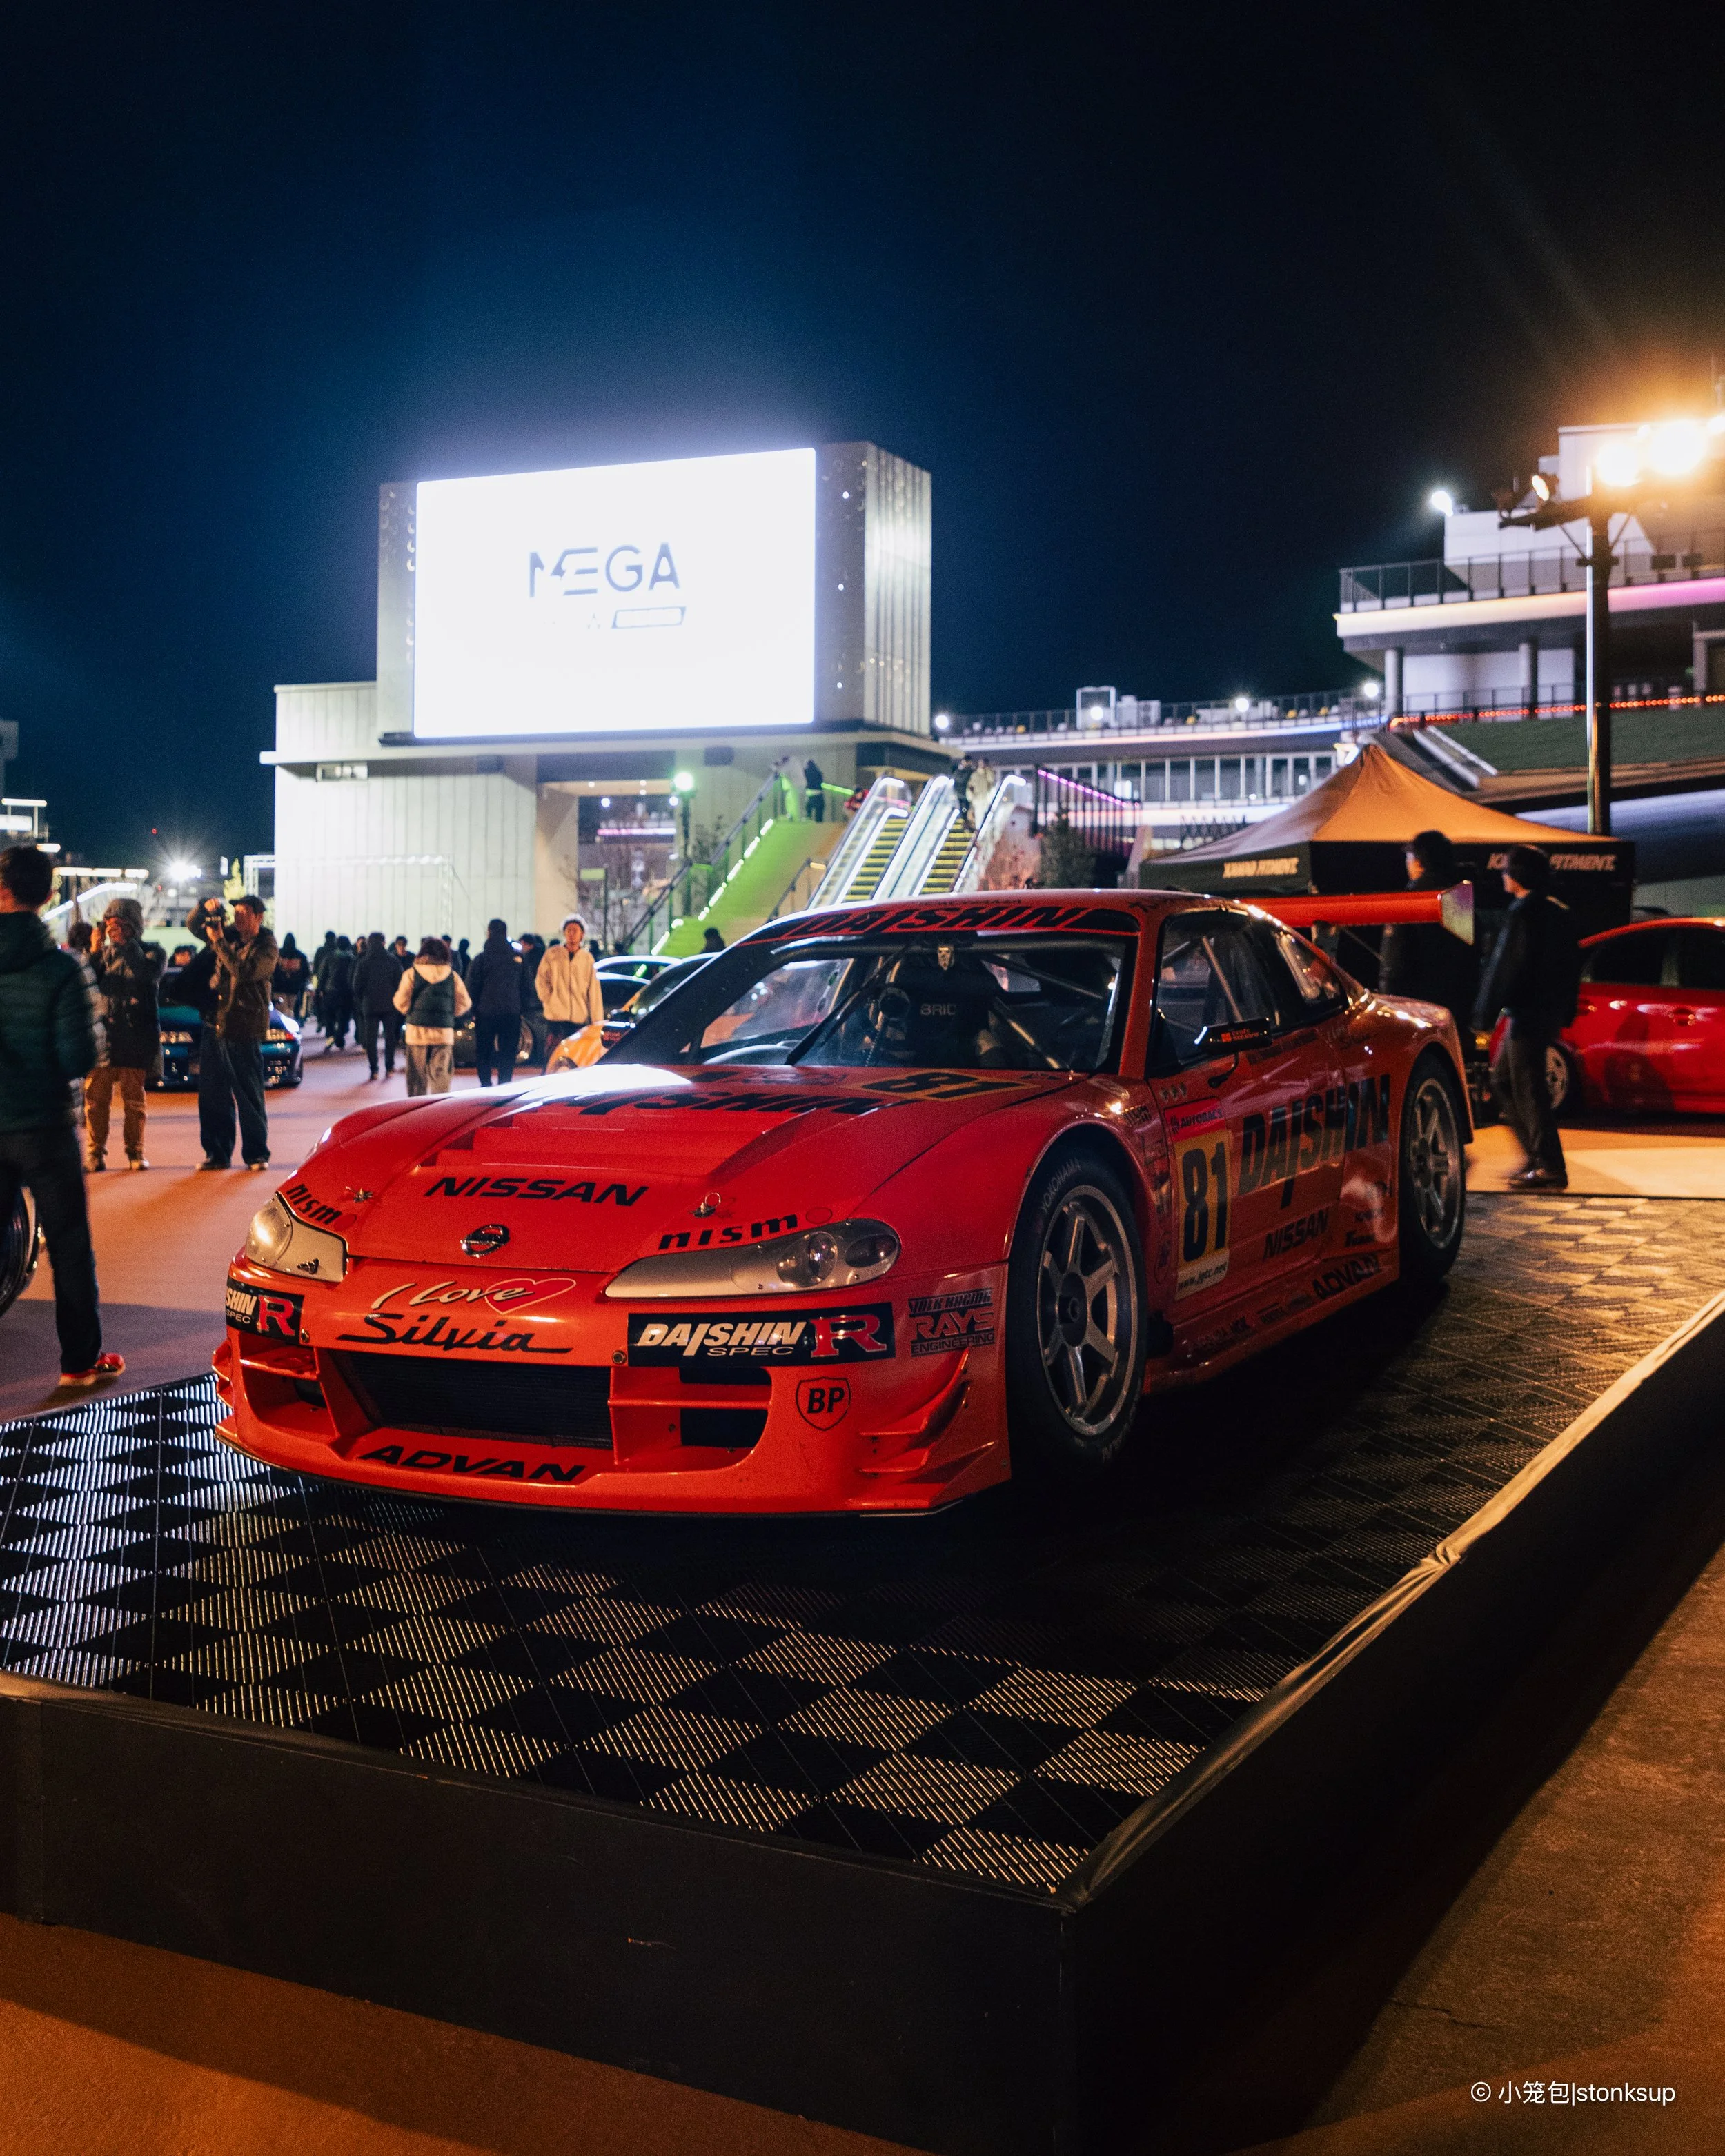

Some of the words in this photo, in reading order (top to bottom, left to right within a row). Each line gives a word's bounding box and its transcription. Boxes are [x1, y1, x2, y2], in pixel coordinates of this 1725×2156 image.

[529, 542, 680, 597] MEGA
[795, 907, 1088, 934] DAISHIN
[1238, 1074, 1390, 1209] DAISHIN
[424, 1176, 649, 1207] NISSAN
[1040, 1157, 1082, 1214] YOKOHAMA
[1182, 1140, 1228, 1263] 81
[1263, 1206, 1330, 1263] NISSAN
[410, 1281, 535, 1306] Love
[1312, 1254, 1382, 1300] ADVAN
[226, 1309, 252, 1324] SPEC
[258, 1295, 296, 1336] R
[336, 1312, 573, 1354] Silvia
[909, 1306, 994, 1340] RAYS
[638, 1321, 808, 1356] DAISHIN
[707, 1346, 795, 1356] SPEC
[809, 1314, 887, 1358] R
[911, 1332, 995, 1354] ENGINEERING
[807, 1386, 845, 1414] BP
[362, 1445, 586, 1482] ADVAN
